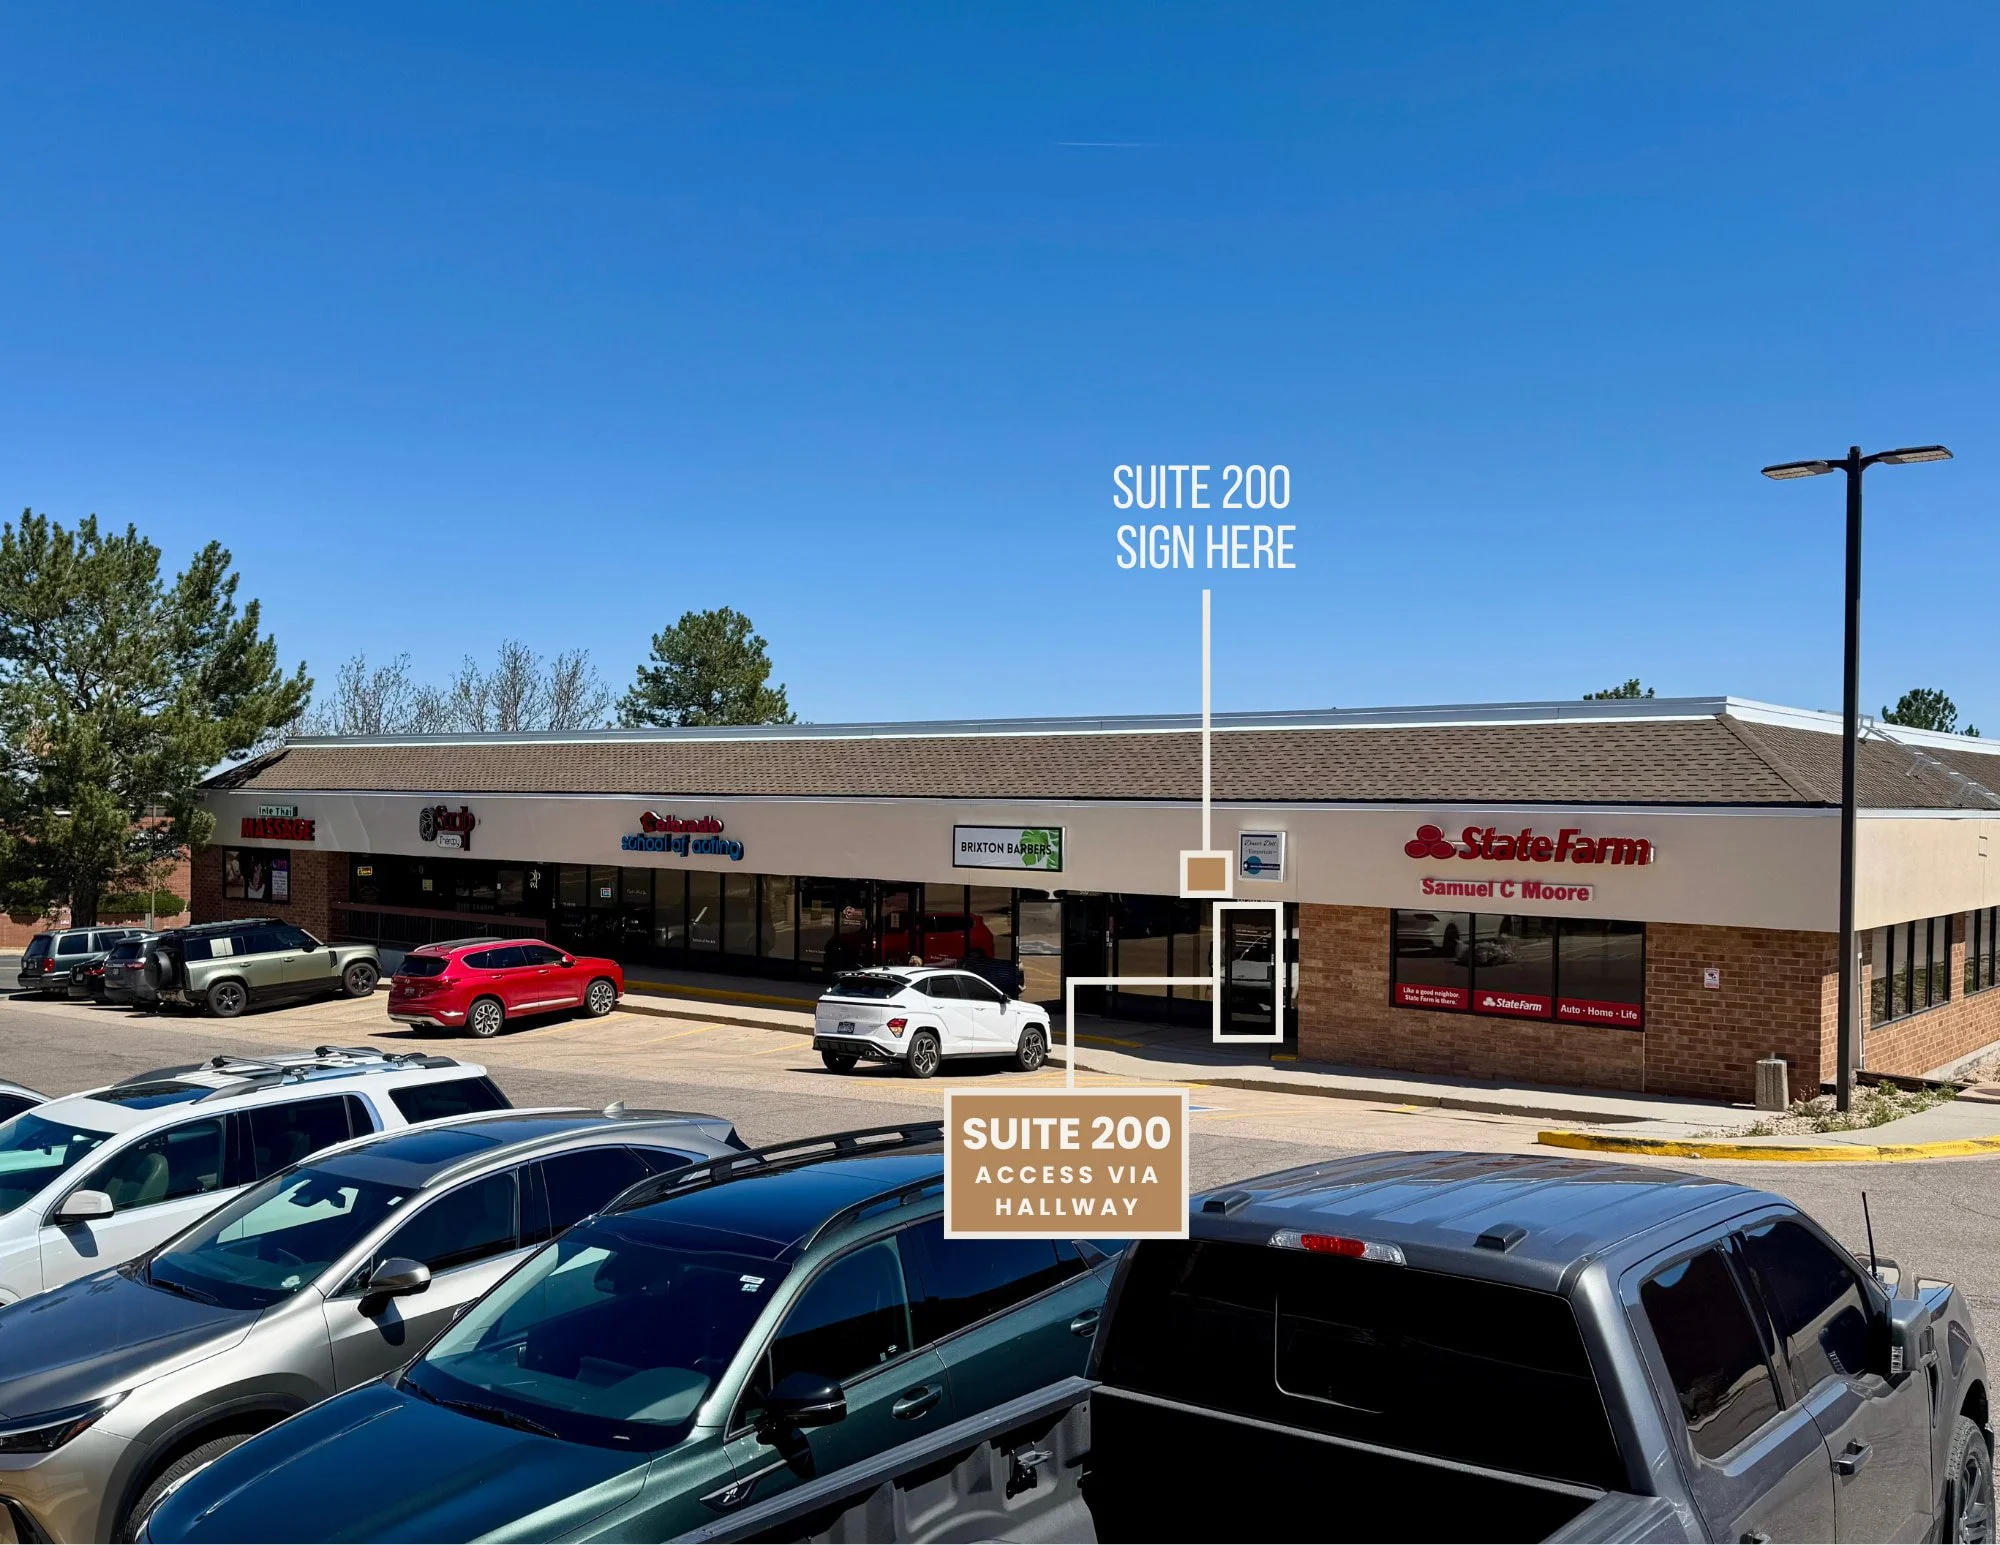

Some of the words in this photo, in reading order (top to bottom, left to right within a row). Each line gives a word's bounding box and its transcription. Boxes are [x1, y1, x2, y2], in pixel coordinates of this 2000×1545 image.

[241, 818, 315, 841] MASSAGE
[640, 811, 725, 833] Colorado
[621, 833, 672, 852] school
[671, 835, 691, 857] of
[692, 836, 745, 861] acting
[961, 842, 1004, 854] BRIXTON
[1007, 843, 1052, 855] BARBERS
[1422, 878, 1494, 898] Samuel
[1499, 880, 1515, 898] C
[1521, 882, 1590, 901] Moore
[1560, 1004, 1581, 1014] Auto
[1587, 1007, 1614, 1018] Home
[1621, 1010, 1638, 1020] Life
